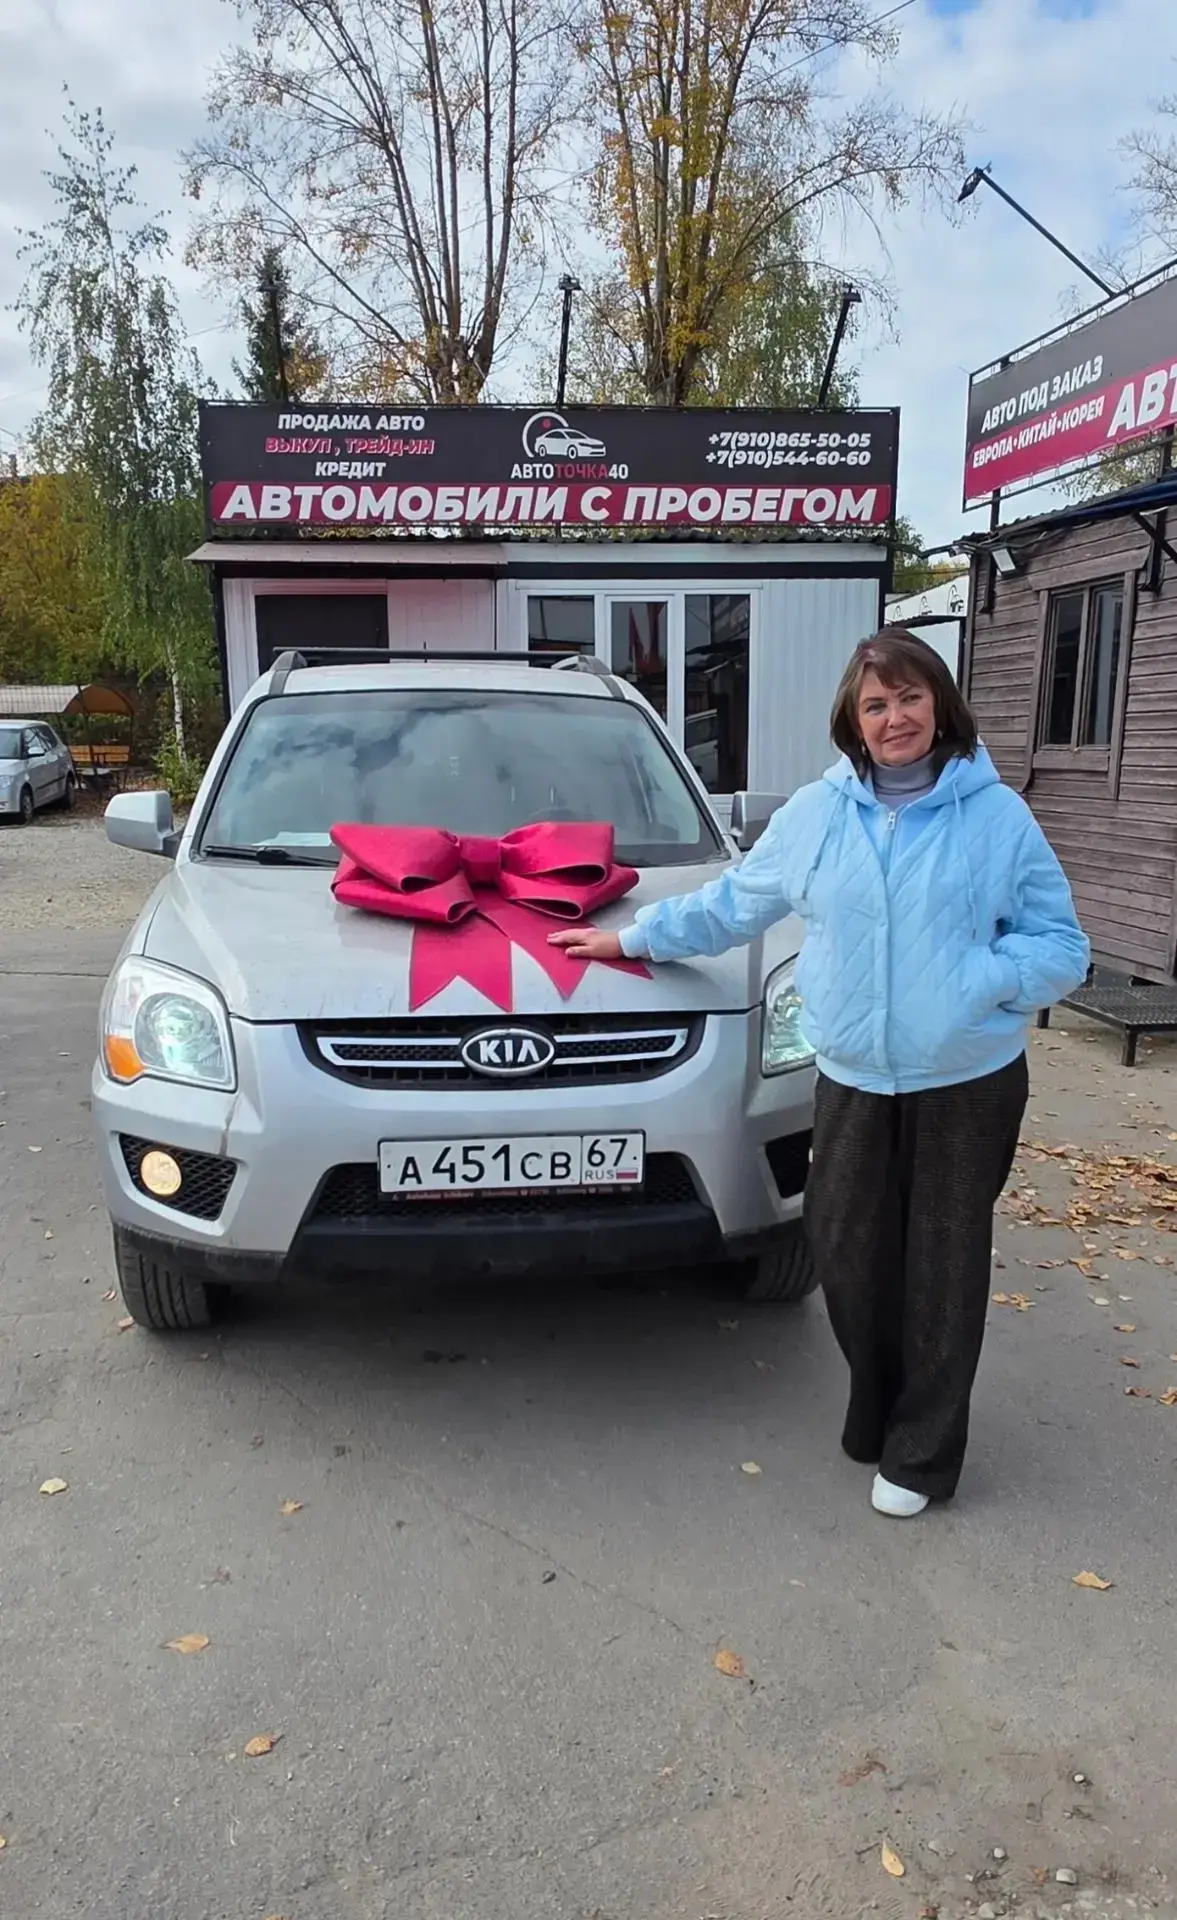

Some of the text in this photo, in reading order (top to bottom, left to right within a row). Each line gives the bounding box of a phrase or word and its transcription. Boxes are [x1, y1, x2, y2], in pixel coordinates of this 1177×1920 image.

[981, 355, 1103, 433] АВТО ПОД ЗАКАЗ
[1107, 363, 1177, 438] АВ
[278, 414, 425, 432] ПРОДАЖА АВТО
[345, 435, 435, 457] ТРЕЙД-ИН
[708, 431, 871, 449] +7(910)865-50-05
[705, 449, 871, 468] +7(910)544-60-60
[315, 461, 386, 479] КРЕДИТ
[511, 463, 628, 480] АВТОТОЧКА40
[220, 485, 877, 522] АВТОМОБИЛИ С ПРОБЕГОМ
[478, 1039, 540, 1063] KIA
[587, 1138, 628, 1168] 67
[584, 1169, 615, 1181] RUS
